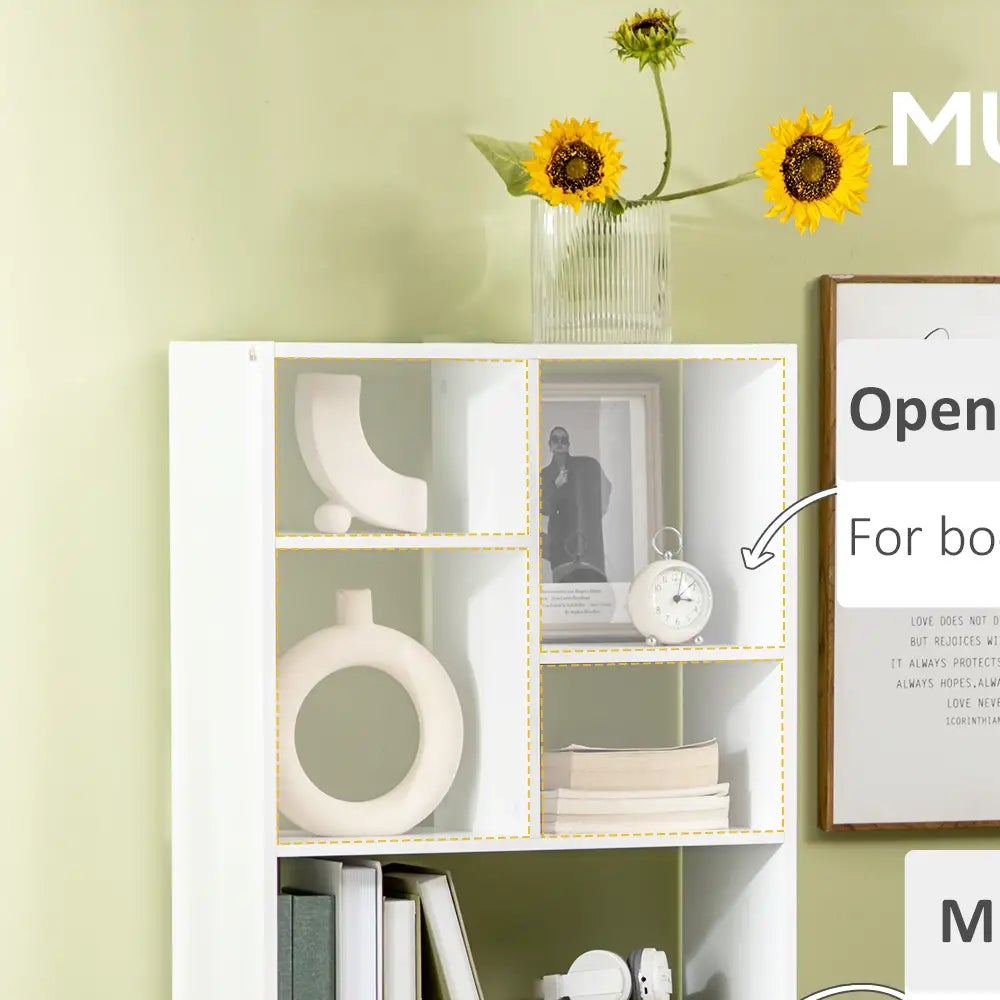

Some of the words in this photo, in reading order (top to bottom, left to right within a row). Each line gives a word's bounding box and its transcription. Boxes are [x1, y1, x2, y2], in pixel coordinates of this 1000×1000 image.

[910, 616, 934, 627] LOVE
[939, 616, 964, 627] DOES
[969, 615, 987, 626] NOT
[910, 636, 928, 647] BUT
[934, 636, 982, 647] REJOICES
[891, 658, 903, 669] IT
[908, 658, 947, 669] ALWAYS
[896, 679, 934, 689] ALWAYS
[947, 698, 971, 709] LOVE
